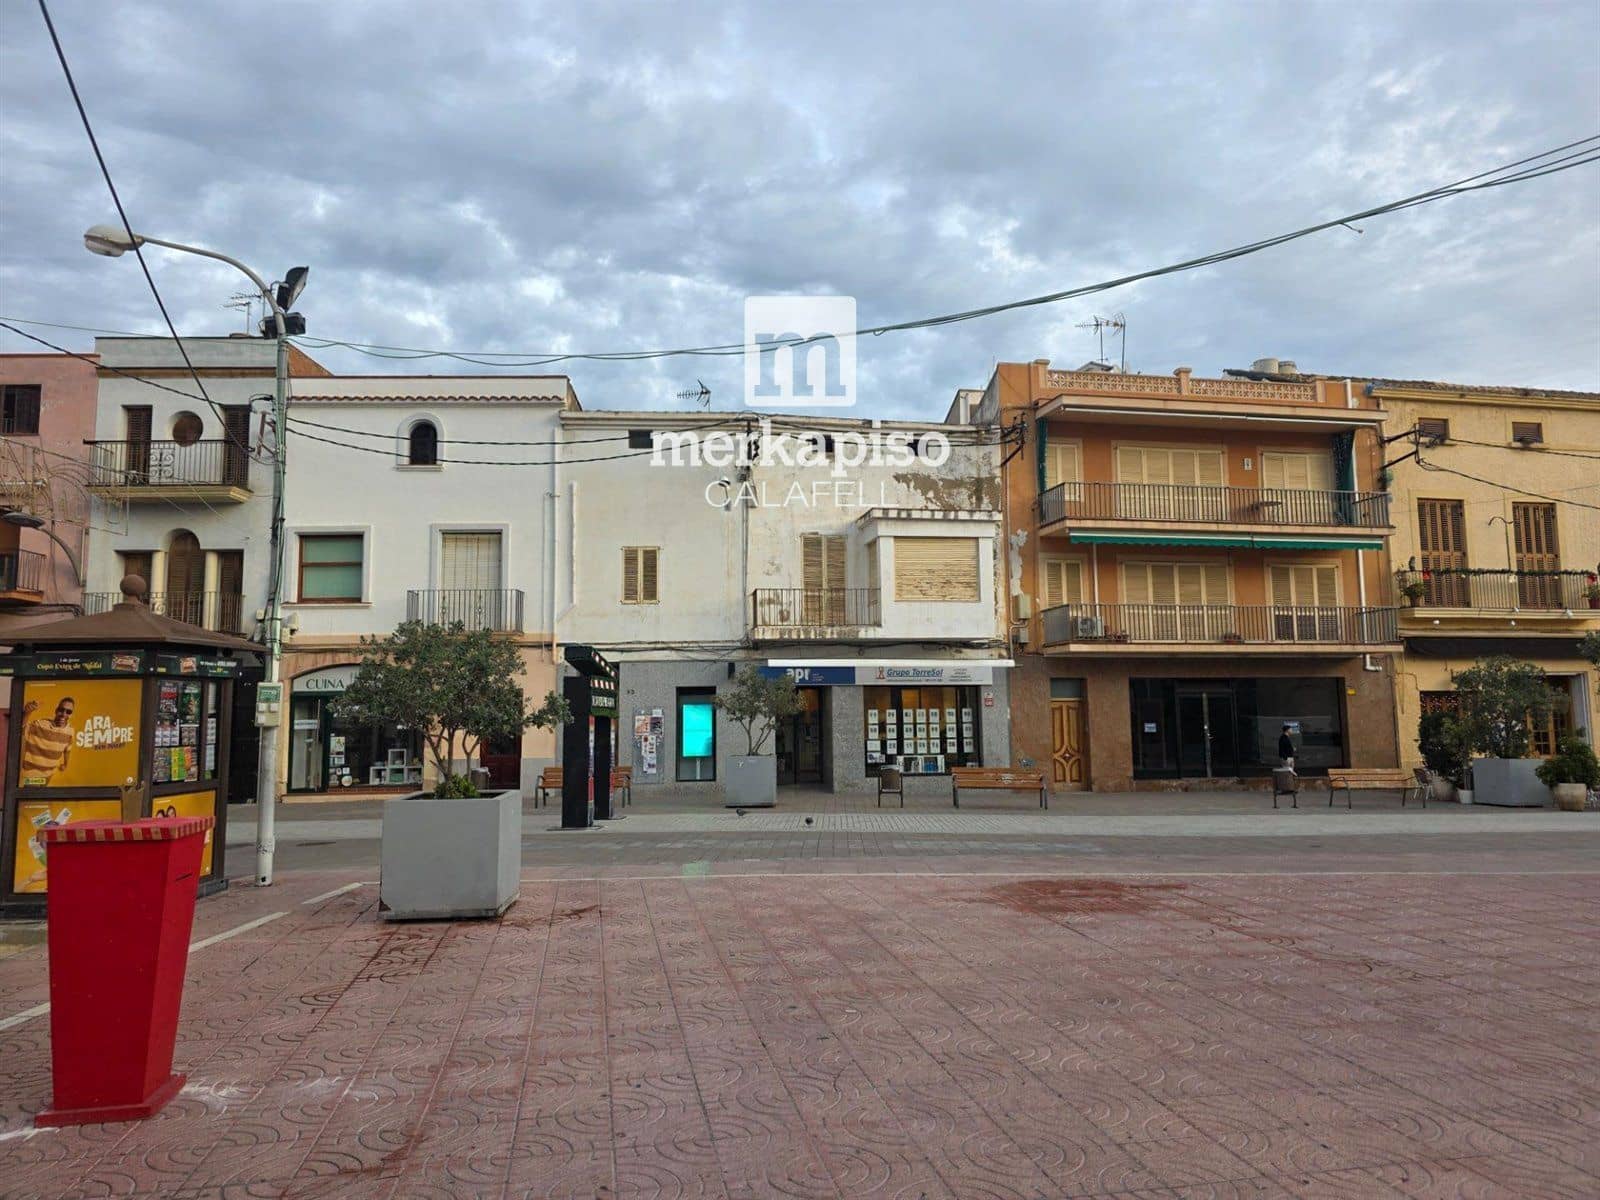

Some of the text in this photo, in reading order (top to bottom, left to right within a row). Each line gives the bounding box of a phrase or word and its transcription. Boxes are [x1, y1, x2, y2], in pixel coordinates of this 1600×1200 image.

[886, 668, 910, 678] Grupo
[912, 668, 944, 677] TorreSol
[306, 678, 345, 689] CUINA
[84, 716, 112, 733] ARA
[76, 727, 134, 748] SEMPRE
